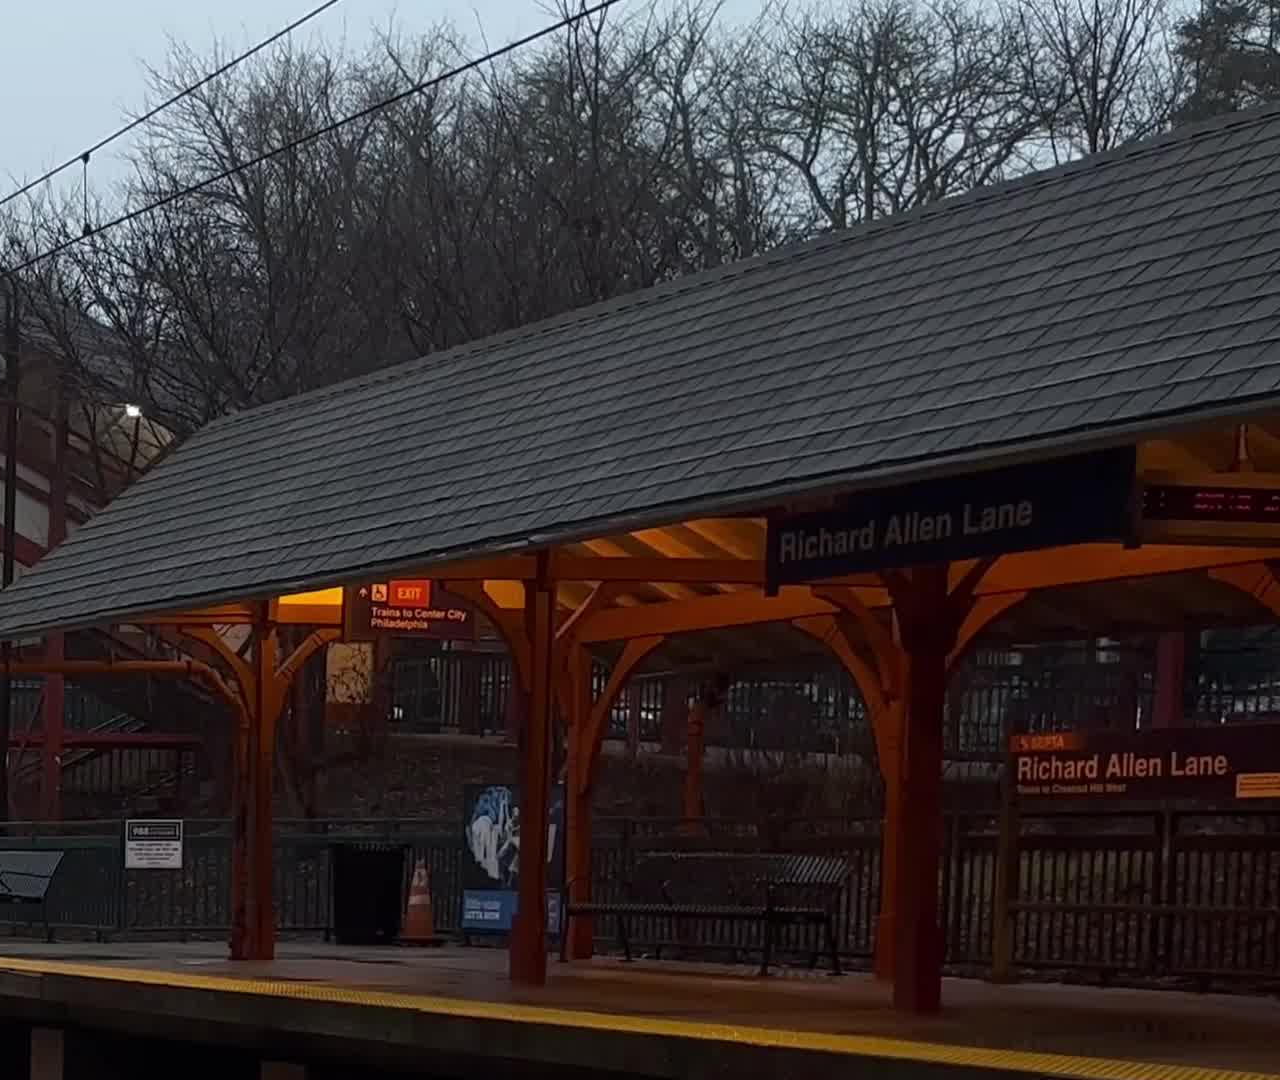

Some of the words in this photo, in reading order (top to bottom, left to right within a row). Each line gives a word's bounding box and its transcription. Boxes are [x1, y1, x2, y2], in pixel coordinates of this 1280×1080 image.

[778, 519, 877, 563] Richard
[884, 510, 953, 549] Allen
[961, 498, 1033, 536] Lane
[397, 587, 423, 600] EXIT
[372, 607, 400, 618] Trains
[402, 608, 413, 619] to
[414, 609, 445, 620] Center
[446, 609, 467, 622] City
[1017, 753, 1099, 782] Richard
[1105, 752, 1162, 778] Allen
[1170, 752, 1229, 776] Lane
